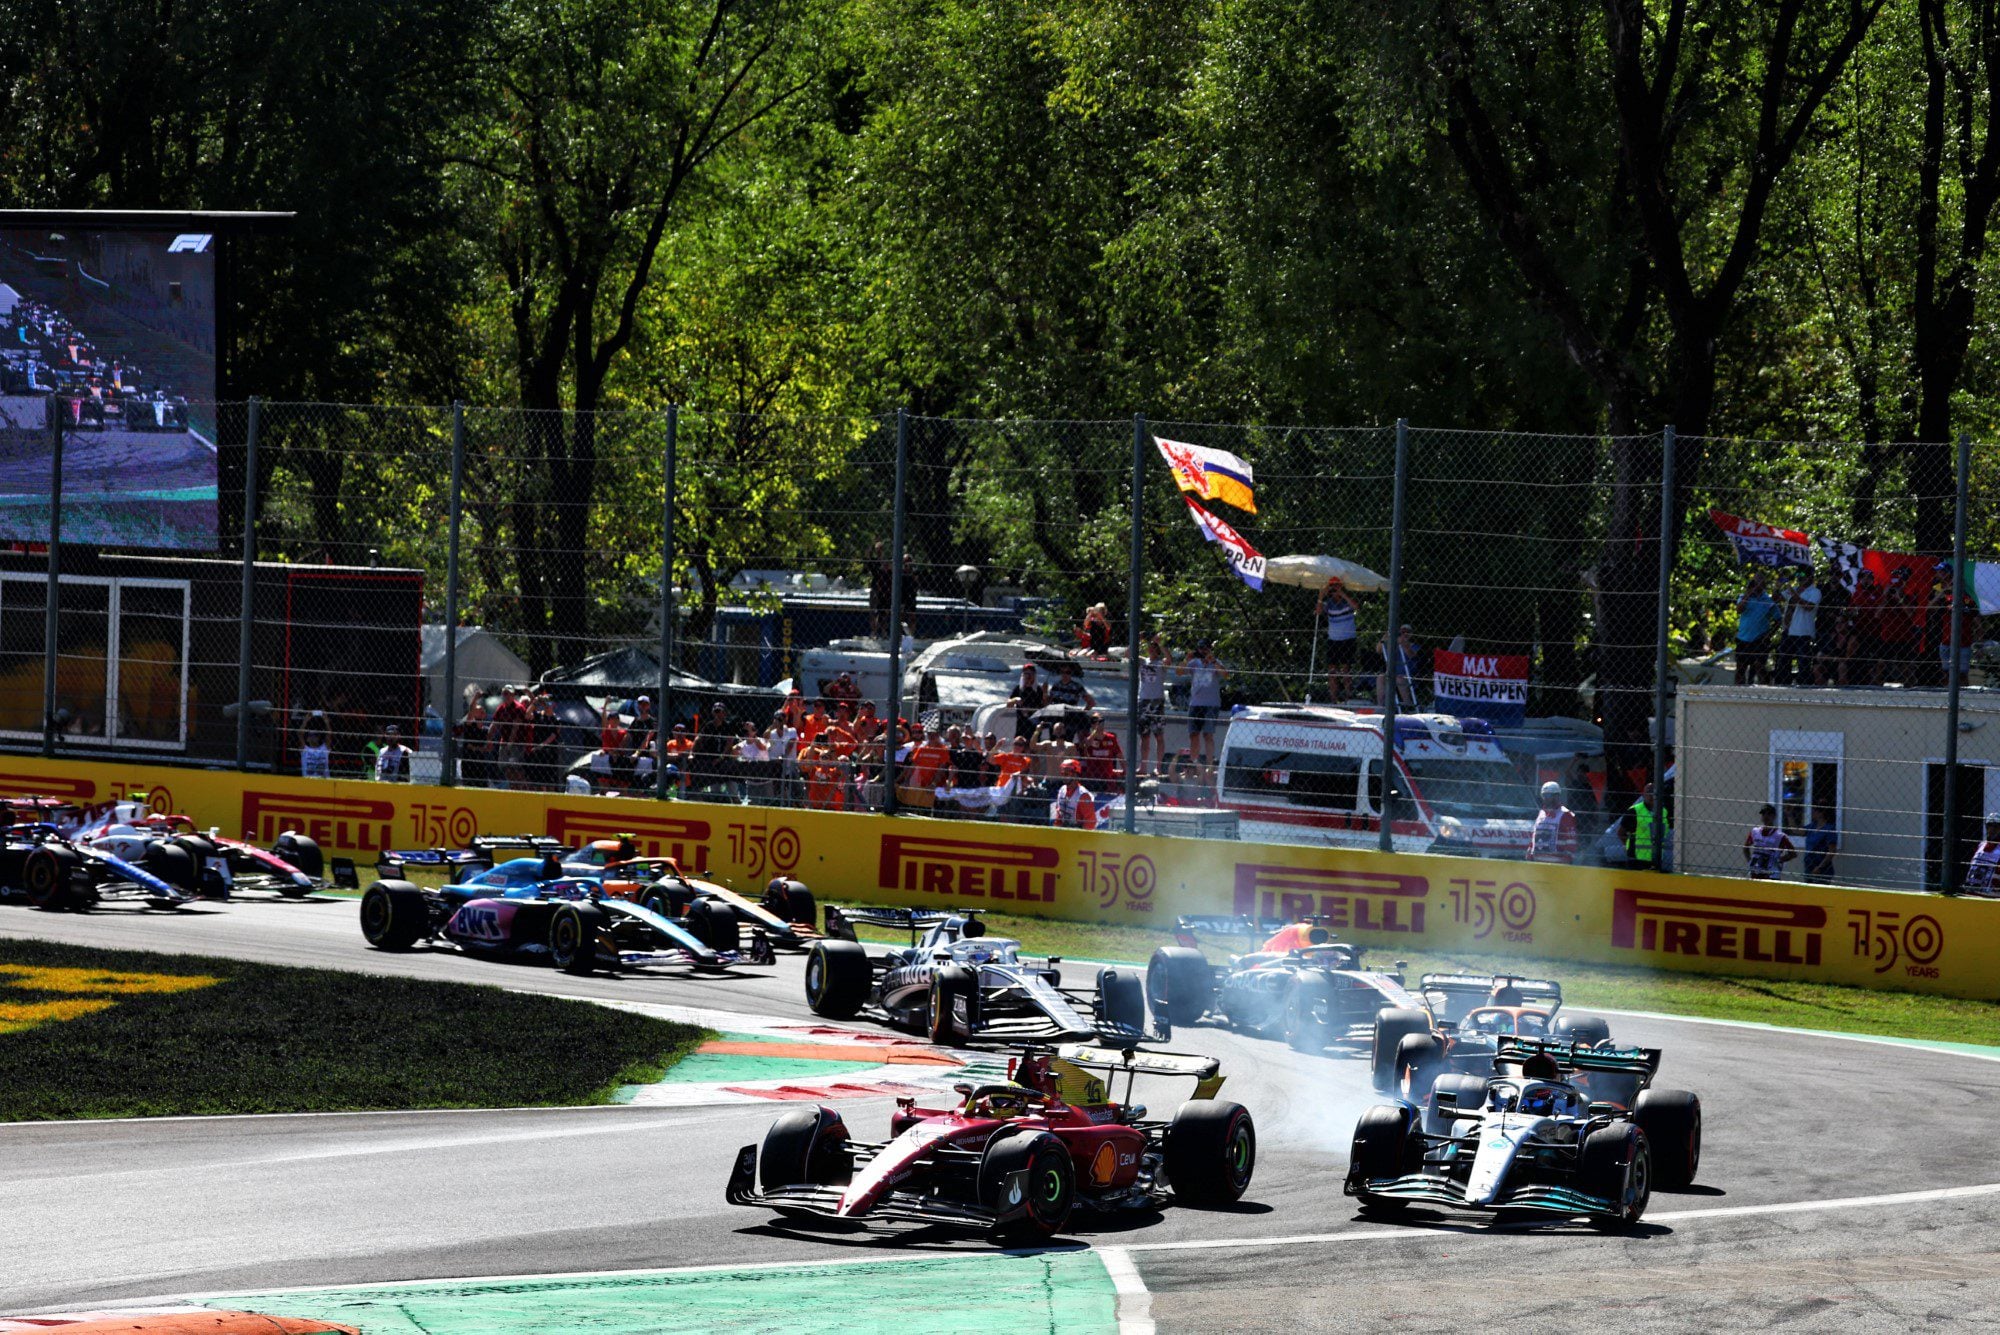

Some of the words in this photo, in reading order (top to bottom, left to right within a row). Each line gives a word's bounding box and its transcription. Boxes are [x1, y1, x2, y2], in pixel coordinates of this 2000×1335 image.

[1202, 511, 1237, 541] MA
[1738, 519, 1786, 539] MAX
[1462, 655, 1499, 677] MAX
[1438, 676, 1527, 700] VERSTAPPEN
[1255, 735, 1281, 747] CROCE
[1282, 737, 1309, 748] ROSSA
[1311, 740, 1347, 751] ITALIANA
[240, 790, 395, 851] PIRELLI
[410, 803, 478, 848] 150
[547, 808, 711, 873] PLLI
[728, 823, 801, 878] 150
[879, 834, 1059, 902] PIRELLI
[1078, 850, 1156, 908] 150
[1125, 900, 1154, 912] YEARS
[1234, 863, 1429, 933] PIRELLI
[1450, 879, 1536, 939] 150
[457, 906, 503, 939] BWT
[1611, 889, 1827, 966] PIRELLI
[1848, 909, 1944, 973] 150
[1501, 932, 1533, 944] YEARS
[1905, 965, 1940, 979] YEARS
[1084, 1079, 1101, 1103] 16
